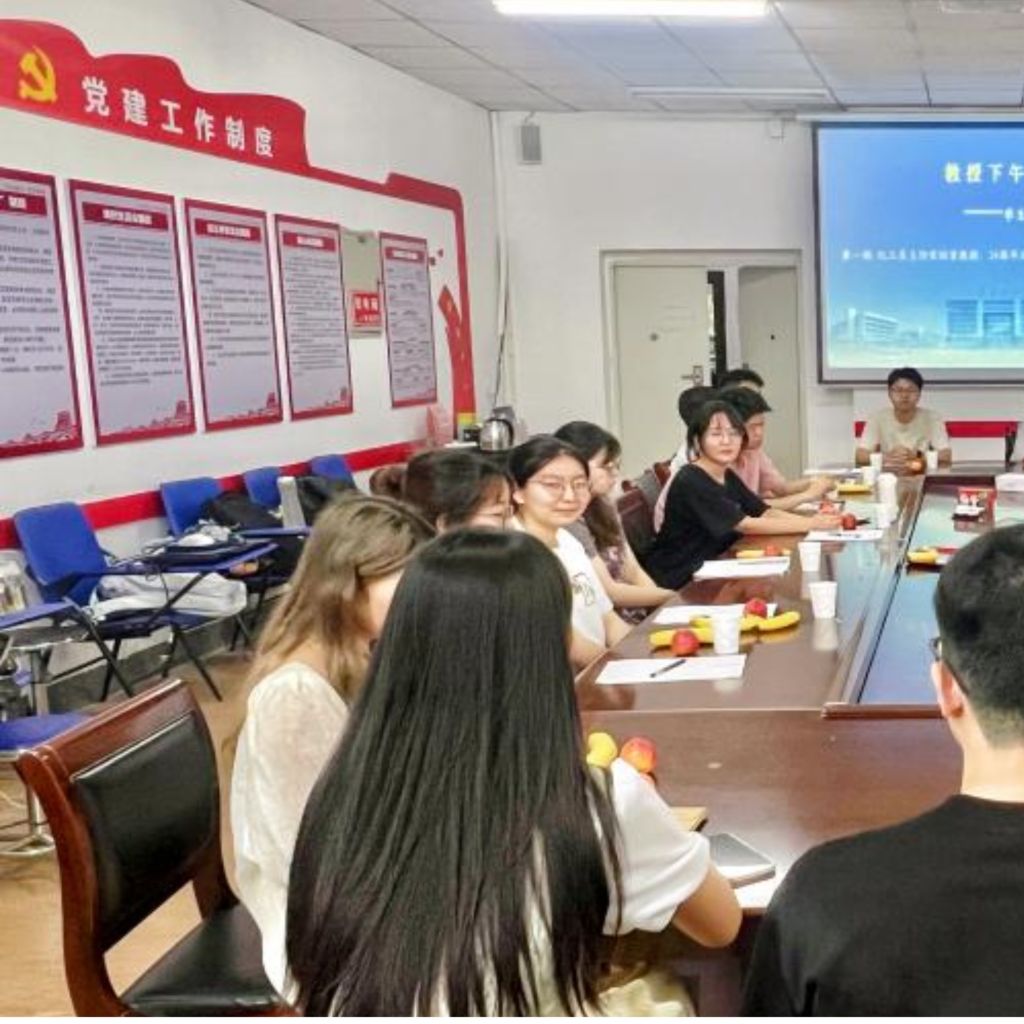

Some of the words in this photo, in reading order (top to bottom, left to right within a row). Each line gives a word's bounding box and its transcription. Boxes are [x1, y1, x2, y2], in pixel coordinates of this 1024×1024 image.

[82, 76, 273, 158] 党建工作制度
